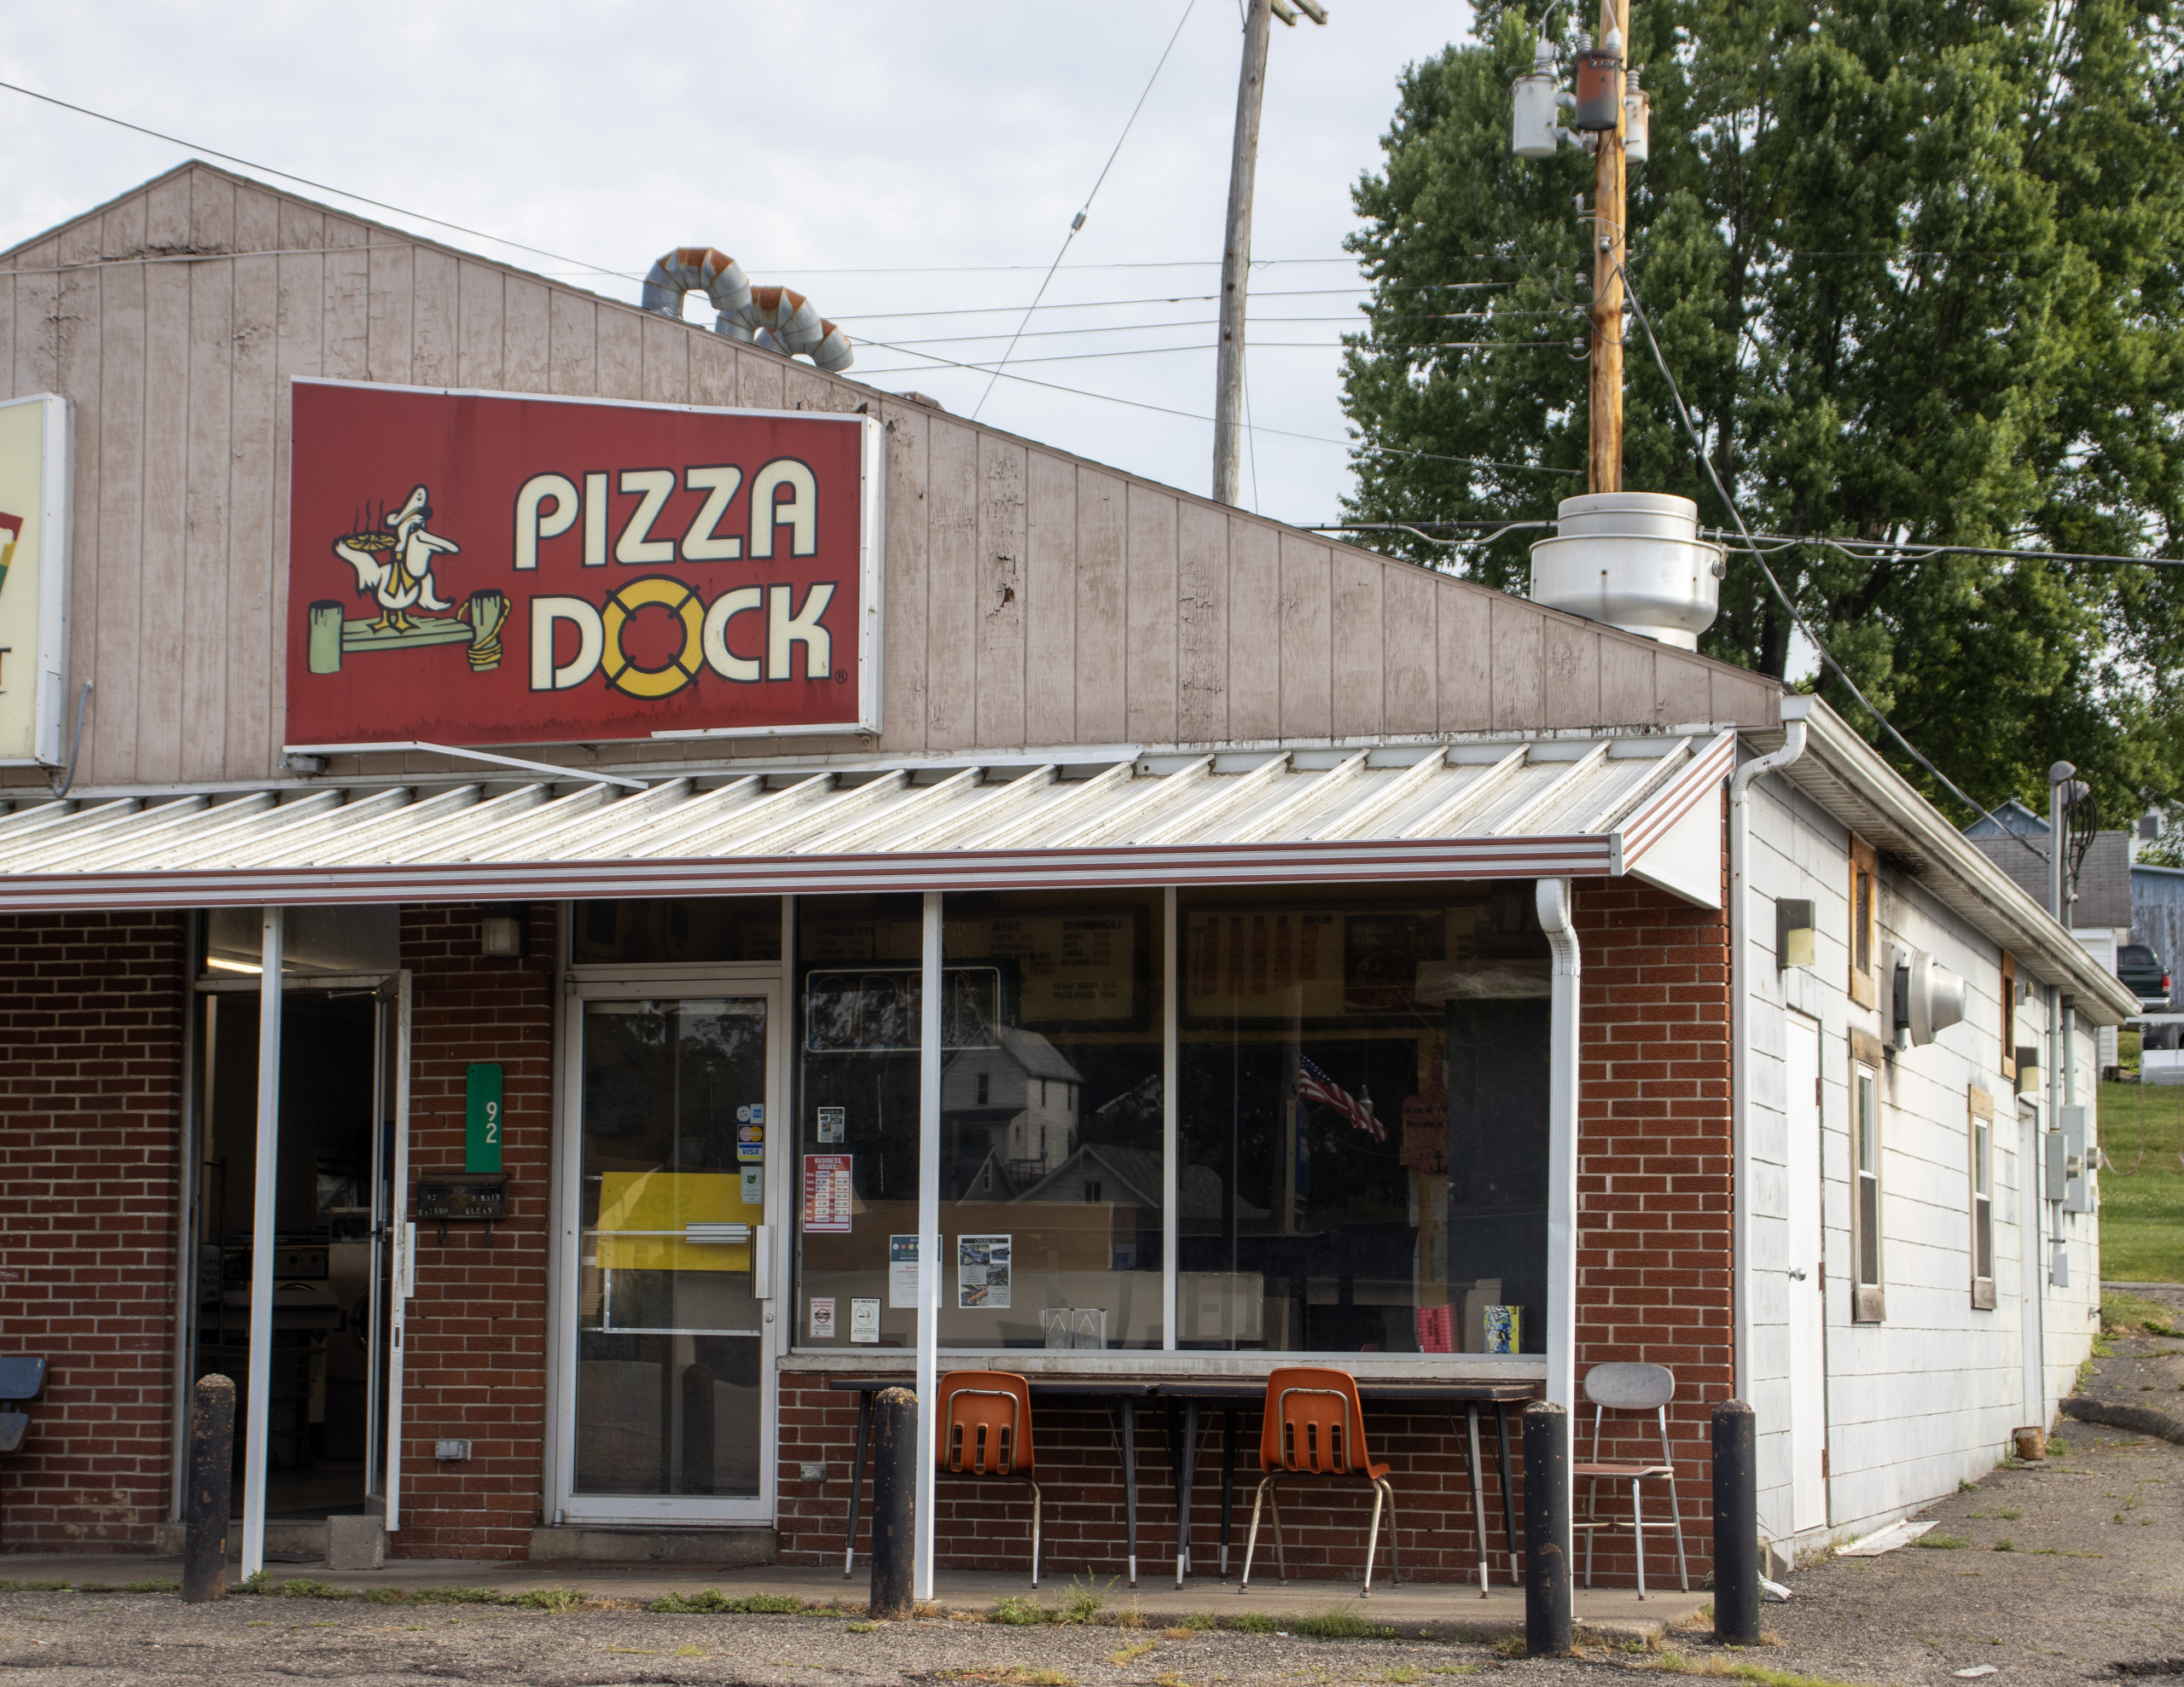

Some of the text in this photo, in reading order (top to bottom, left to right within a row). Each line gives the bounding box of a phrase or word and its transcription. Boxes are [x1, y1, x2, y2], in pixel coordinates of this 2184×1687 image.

[513, 455, 819, 571] PIZZA
[528, 573, 839, 700] DOCK
[485, 1101, 498, 1144] 92
